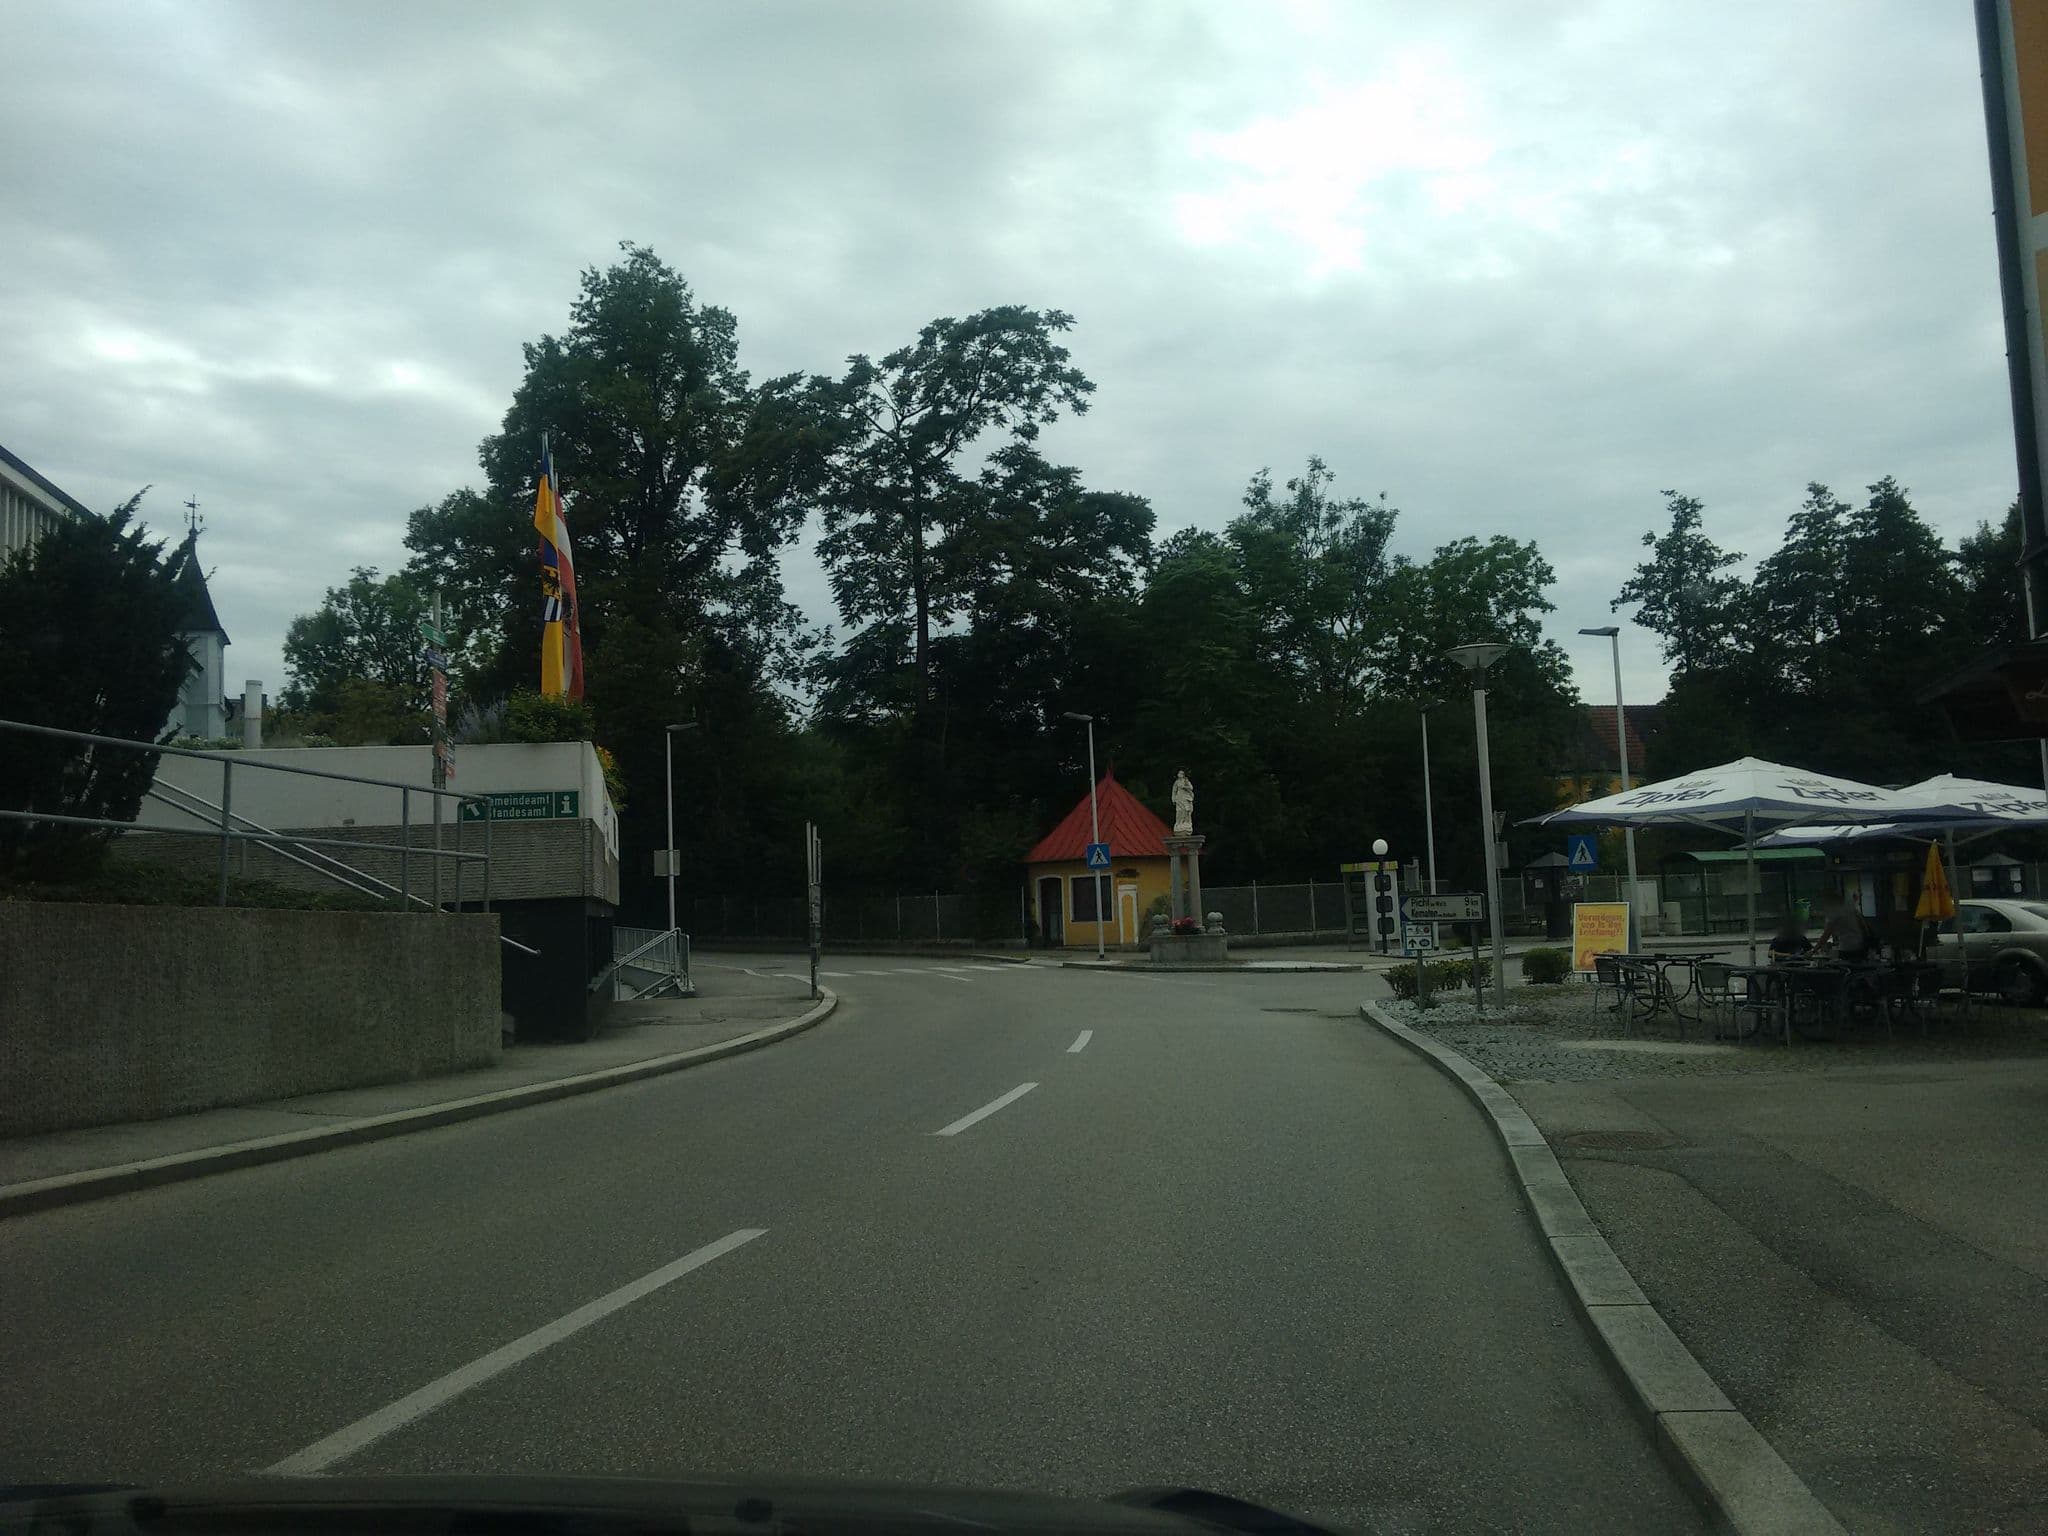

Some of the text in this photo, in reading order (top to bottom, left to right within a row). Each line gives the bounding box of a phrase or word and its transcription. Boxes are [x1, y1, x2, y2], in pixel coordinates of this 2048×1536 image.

[1617, 789, 1726, 808] Zipfer
[1776, 786, 1887, 804] Zipfer
[1464, 897, 1469, 905] 9
